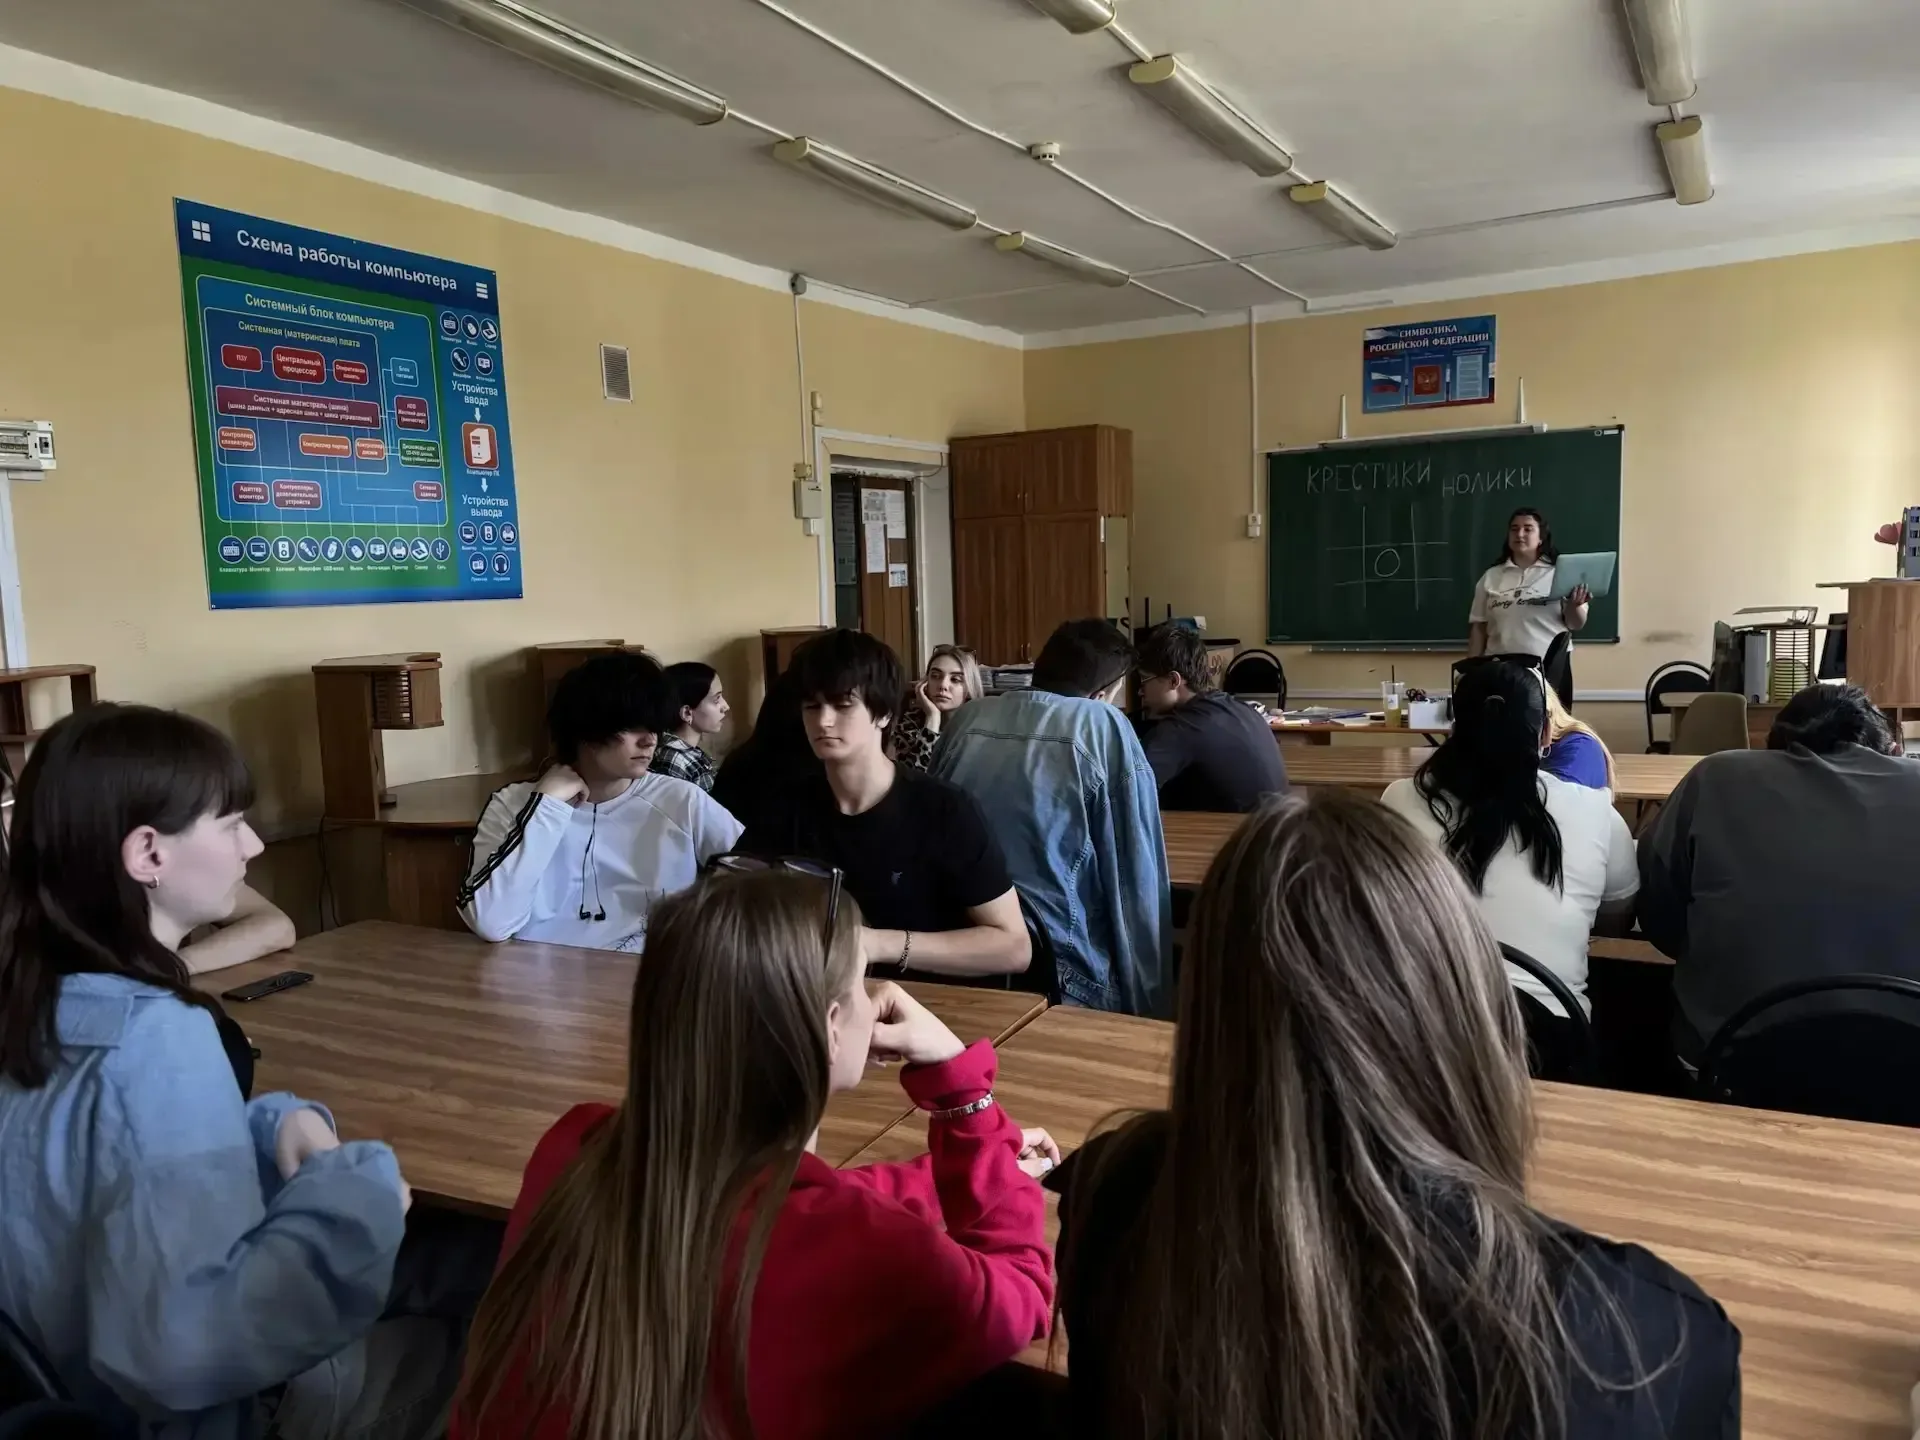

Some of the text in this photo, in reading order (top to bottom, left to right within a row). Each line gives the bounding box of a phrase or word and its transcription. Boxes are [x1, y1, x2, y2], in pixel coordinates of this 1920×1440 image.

[237, 229, 458, 291] Схема работы компьютера
[245, 293, 395, 331] Системный блок компьютера
[238, 320, 360, 348] Системная (материнская) плата
[1400, 324, 1458, 338] СИМВОЛИКА
[1369, 333, 1489, 353] РОССИЙСКОЙ ФЕДЕРАЦИИ
[236, 353, 248, 361] ПЗУ
[276, 353, 321, 366] Центральный
[282, 366, 317, 377] процессор
[451, 380, 499, 396] Устройства
[253, 394, 349, 413] Системная магистраль (шина)
[464, 395, 489, 407] ввода
[227, 402, 246, 410] (шина
[247, 404, 270, 413] данных
[276, 408, 303, 416] адресная
[221, 430, 253, 440] Контроллер
[1306, 457, 1532, 498] КРЕСТИКИ НОЛИКИ
[240, 485, 262, 493] Адаптер
[239, 493, 264, 501] монитора
[462, 494, 509, 507] Устройства
[471, 508, 503, 518] вывода
